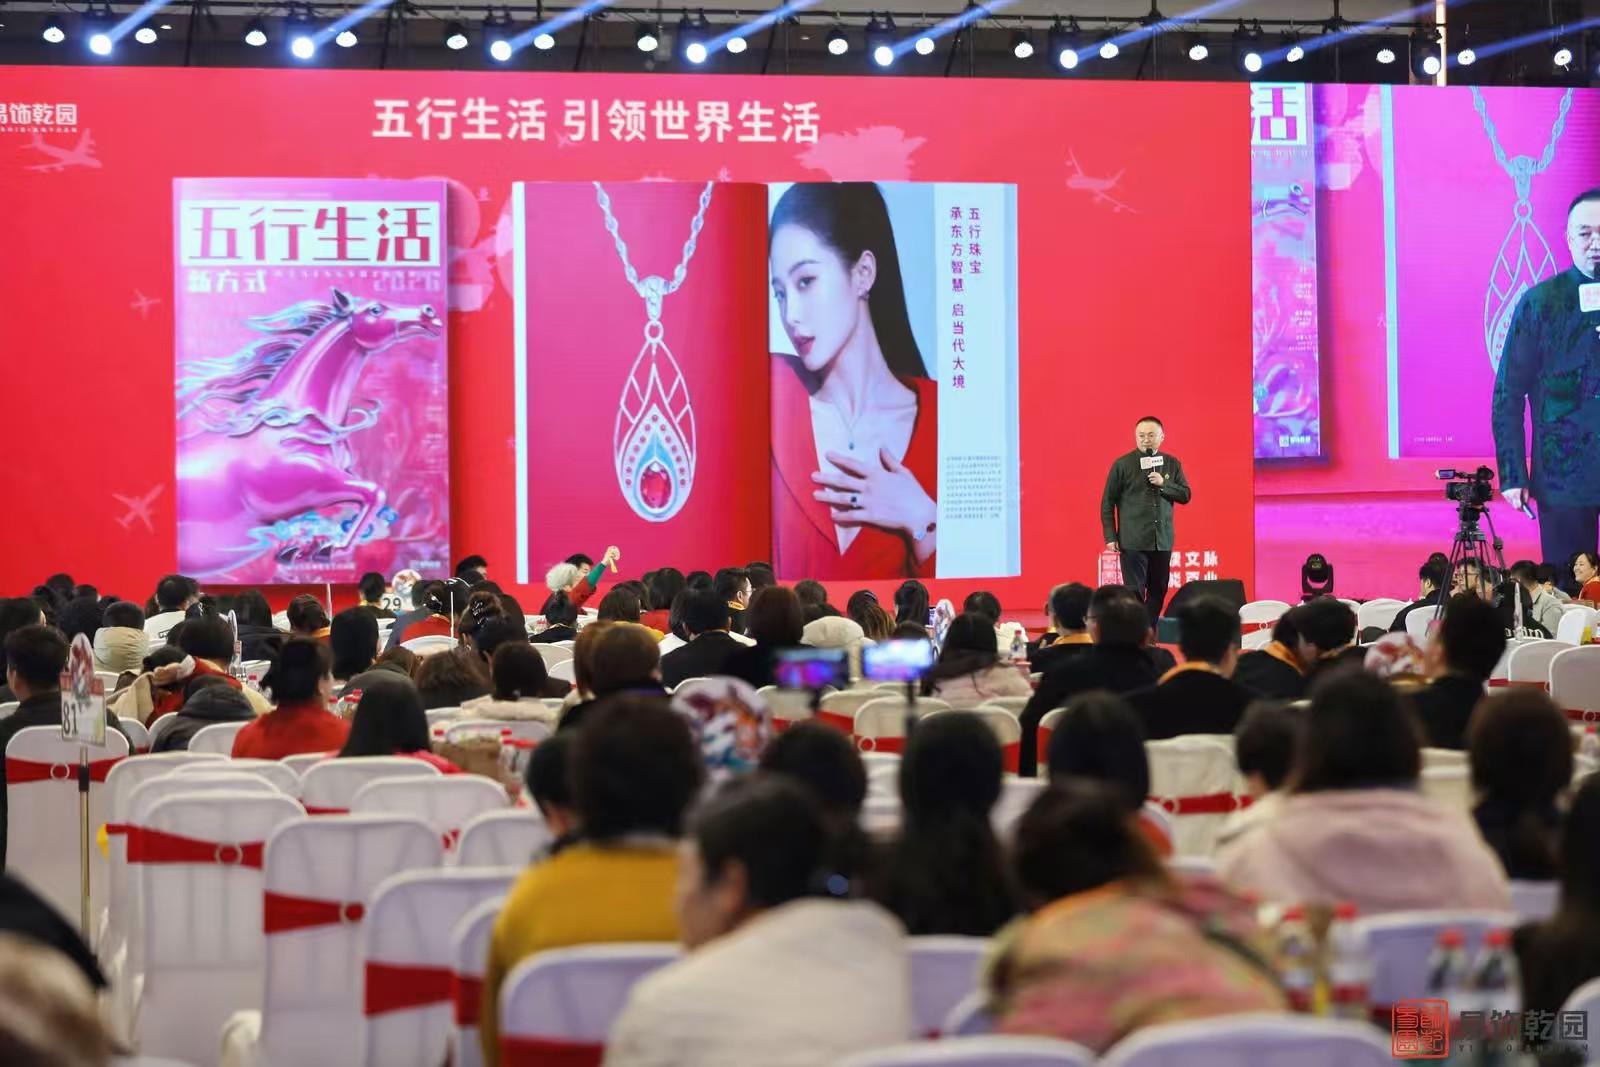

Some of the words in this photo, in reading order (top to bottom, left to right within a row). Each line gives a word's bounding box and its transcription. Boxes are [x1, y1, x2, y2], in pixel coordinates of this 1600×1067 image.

[372, 97, 547, 141] 五行生活
[563, 99, 821, 143] 引领世界生活
[189, 206, 432, 262] 五行生活
[950, 206, 964, 292] 承东方智慧
[968, 207, 982, 274] 五行珠宝
[383, 597, 402, 611] 29
[63, 701, 78, 735] 81
